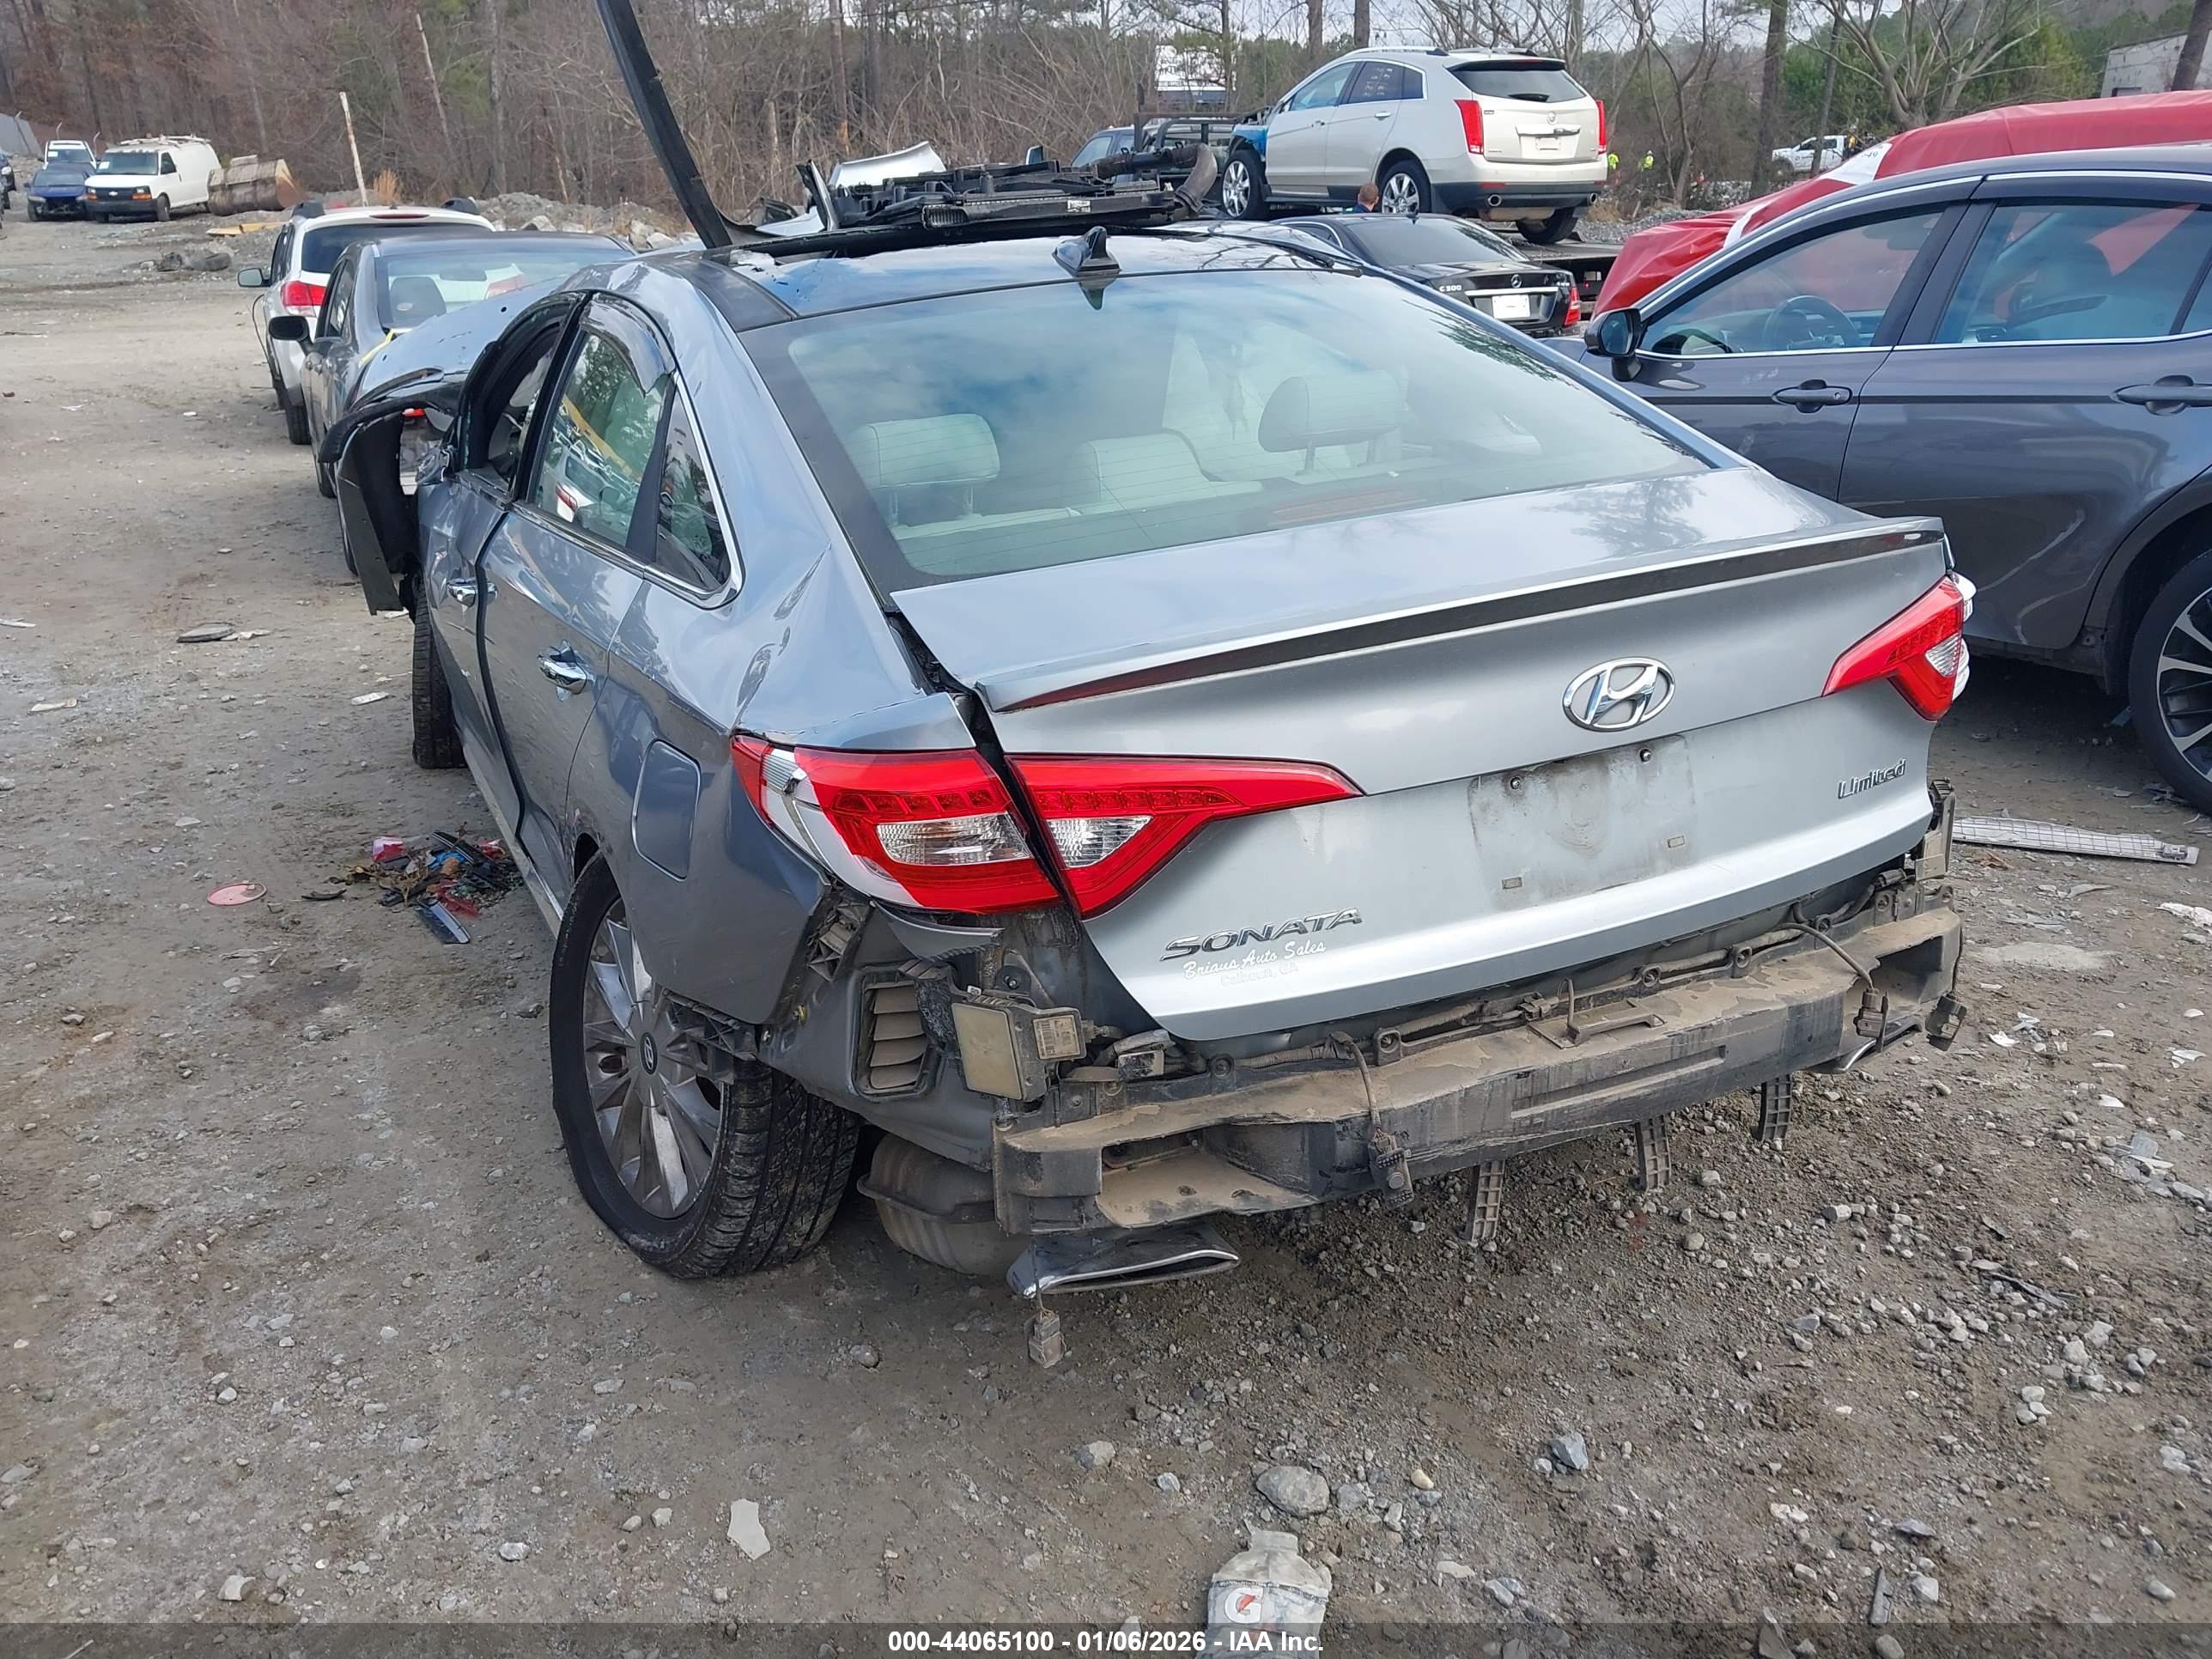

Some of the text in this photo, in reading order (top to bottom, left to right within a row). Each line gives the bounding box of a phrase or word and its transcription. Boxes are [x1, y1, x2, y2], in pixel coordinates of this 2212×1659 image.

[1838, 758, 1906, 799] Limited
[1159, 908, 1364, 962] SONATA
[1239, 949, 1278, 969] Auto
[1284, 939, 1327, 960] Sales
[1224, 1587, 1263, 1624] G
